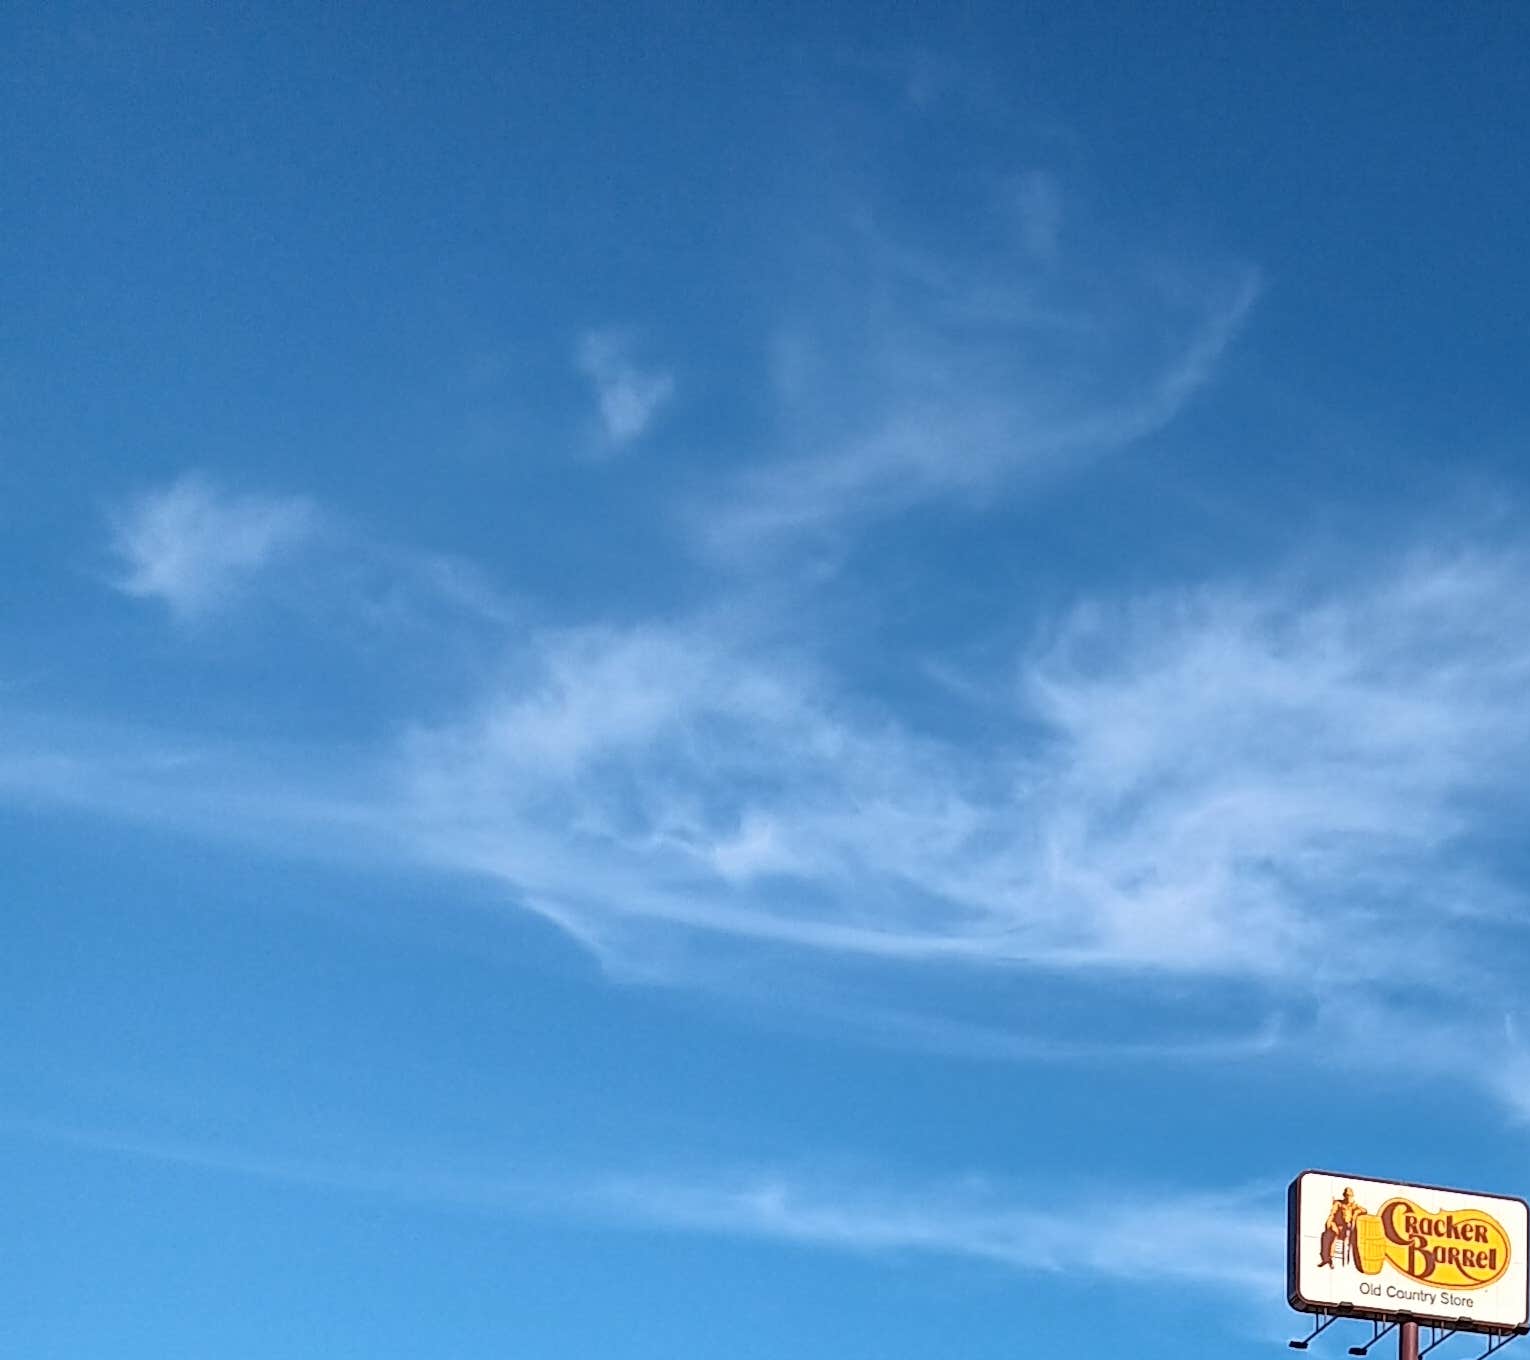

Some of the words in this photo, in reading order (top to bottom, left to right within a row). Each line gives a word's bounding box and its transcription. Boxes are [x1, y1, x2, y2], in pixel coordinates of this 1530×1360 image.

[1381, 1201, 1489, 1245] Cracker
[1408, 1234, 1497, 1280] Barrel
[1359, 1282, 1381, 1297] Old
[1386, 1285, 1437, 1305] Country
[1440, 1292, 1474, 1308] Store
